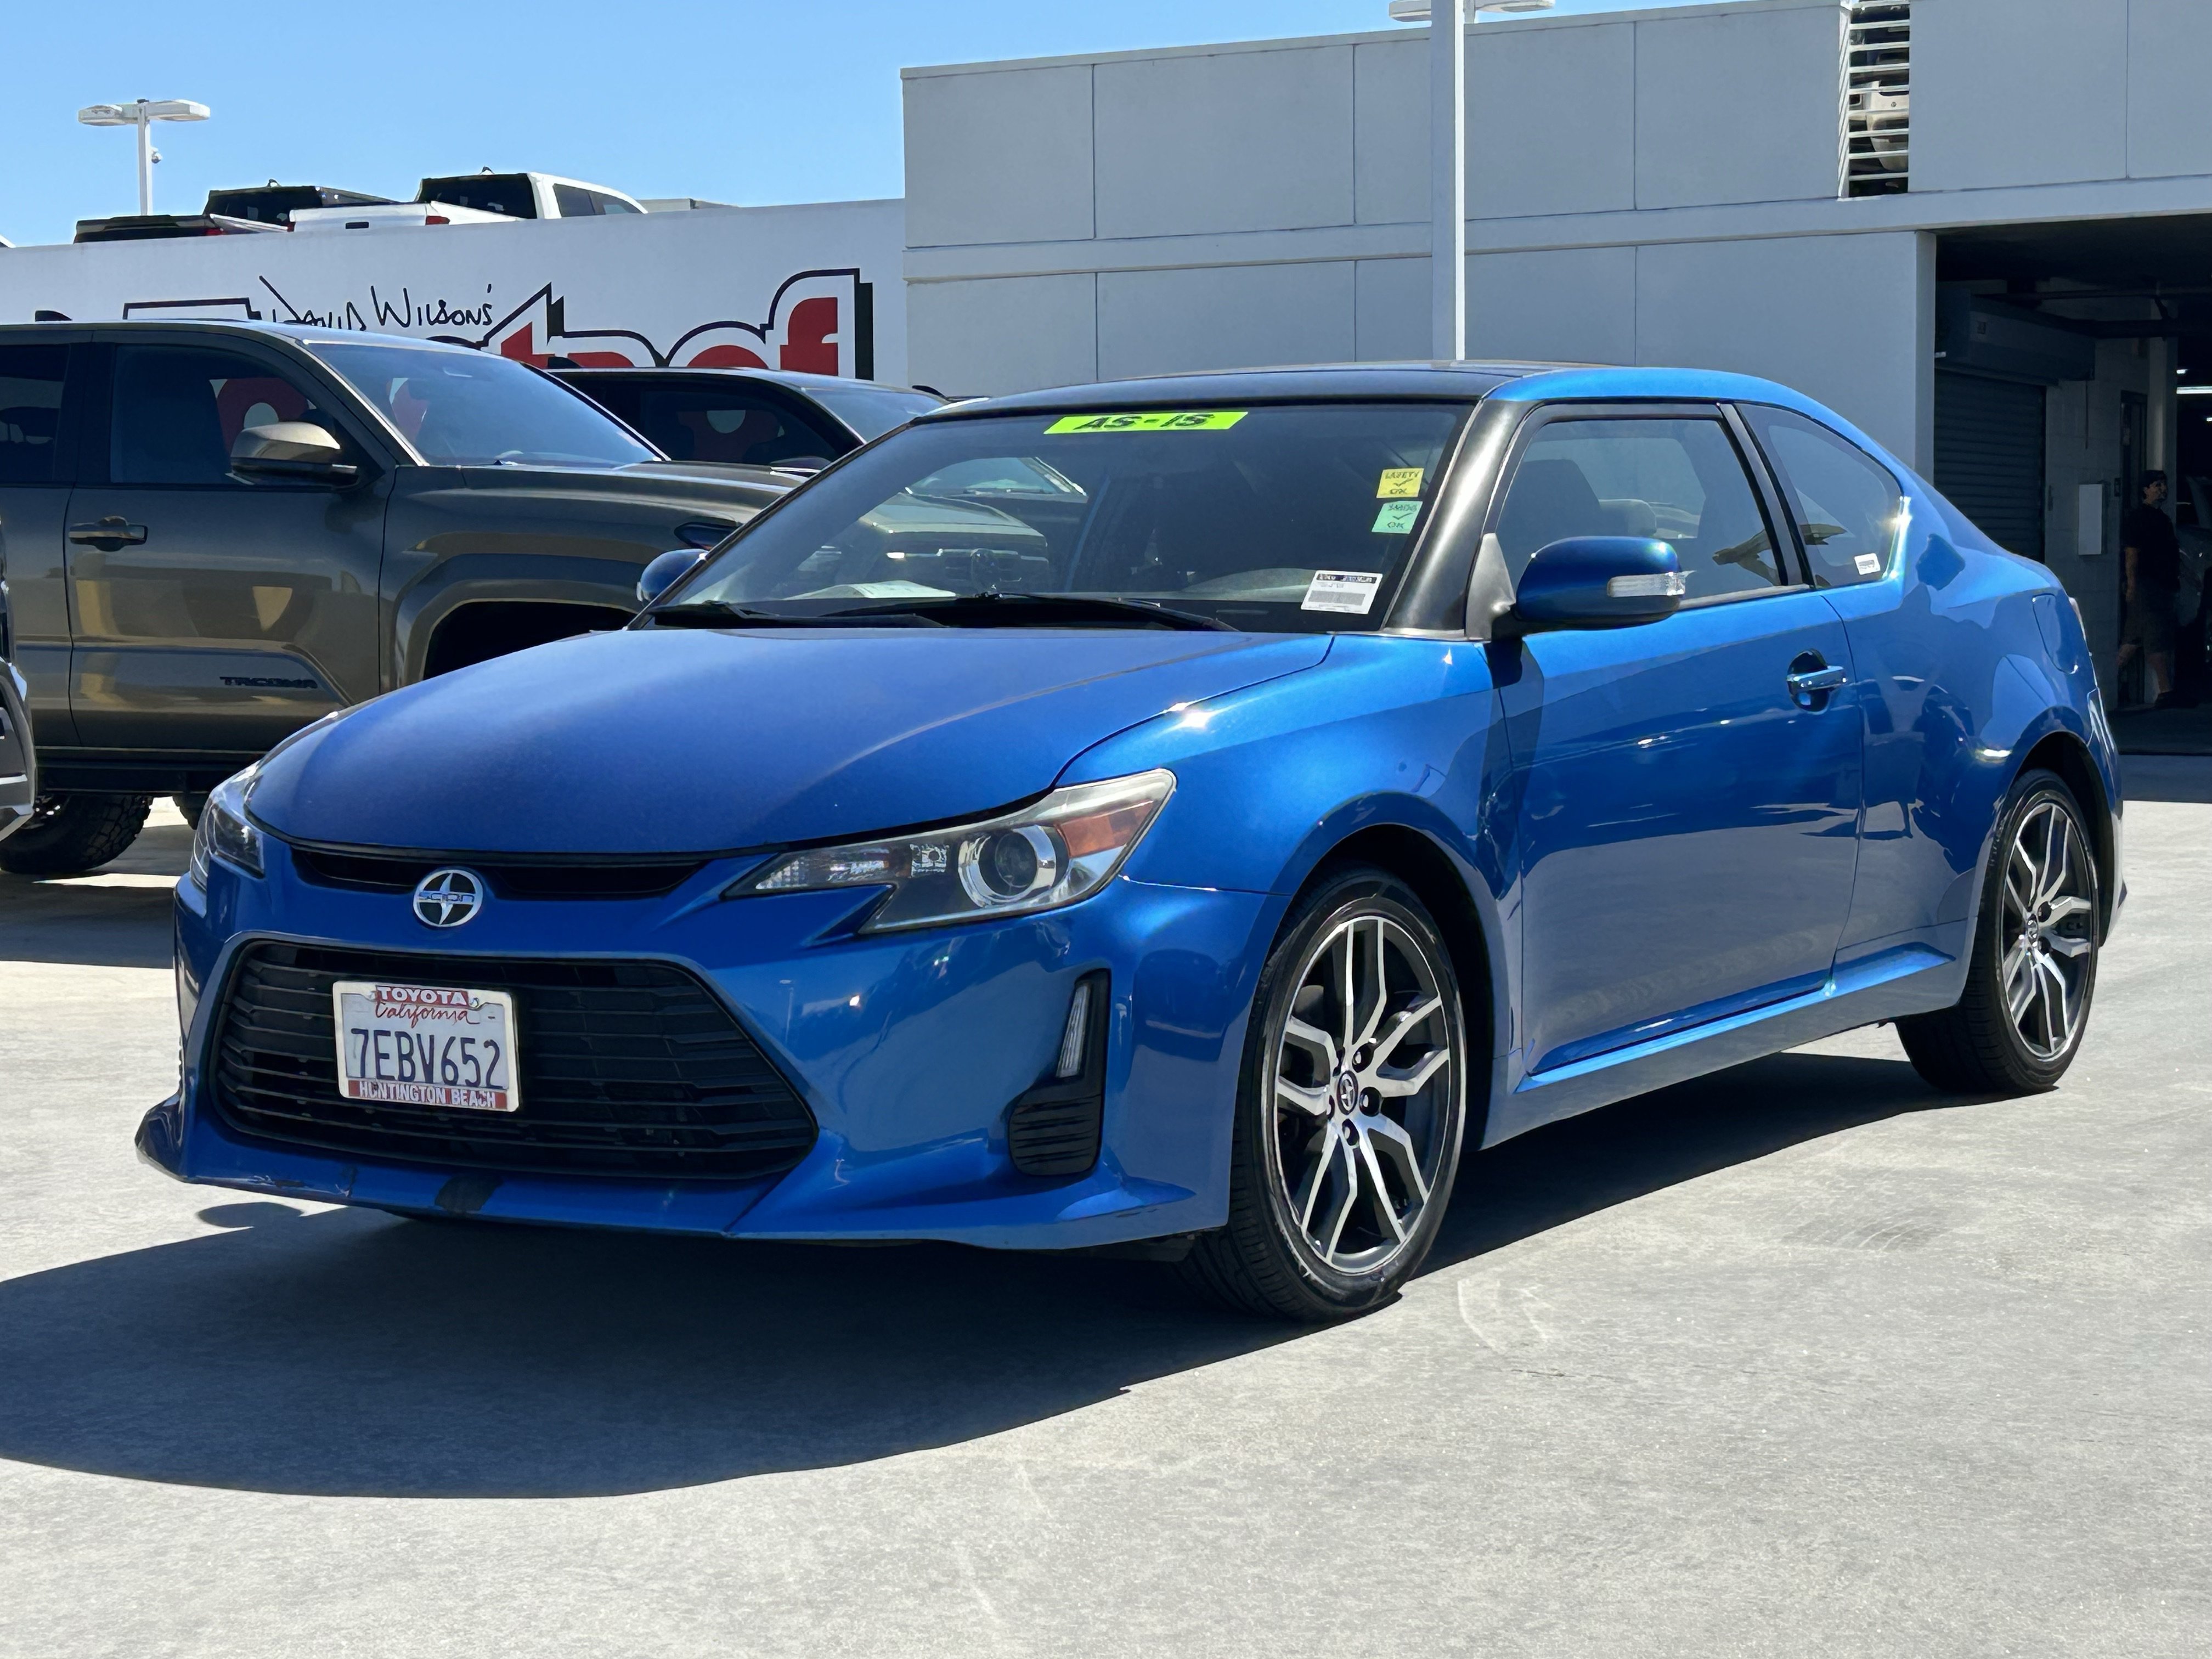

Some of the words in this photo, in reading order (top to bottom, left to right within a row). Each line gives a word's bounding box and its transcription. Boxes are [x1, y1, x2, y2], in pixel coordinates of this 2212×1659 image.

[219, 676, 319, 689] TACOMA
[377, 986, 467, 1006] TOYOTA
[375, 1001, 481, 1029] California
[351, 1028, 504, 1089] 7EBV652
[358, 1080, 447, 1106] HUNTINGTON
[451, 1088, 496, 1108] BEACH
